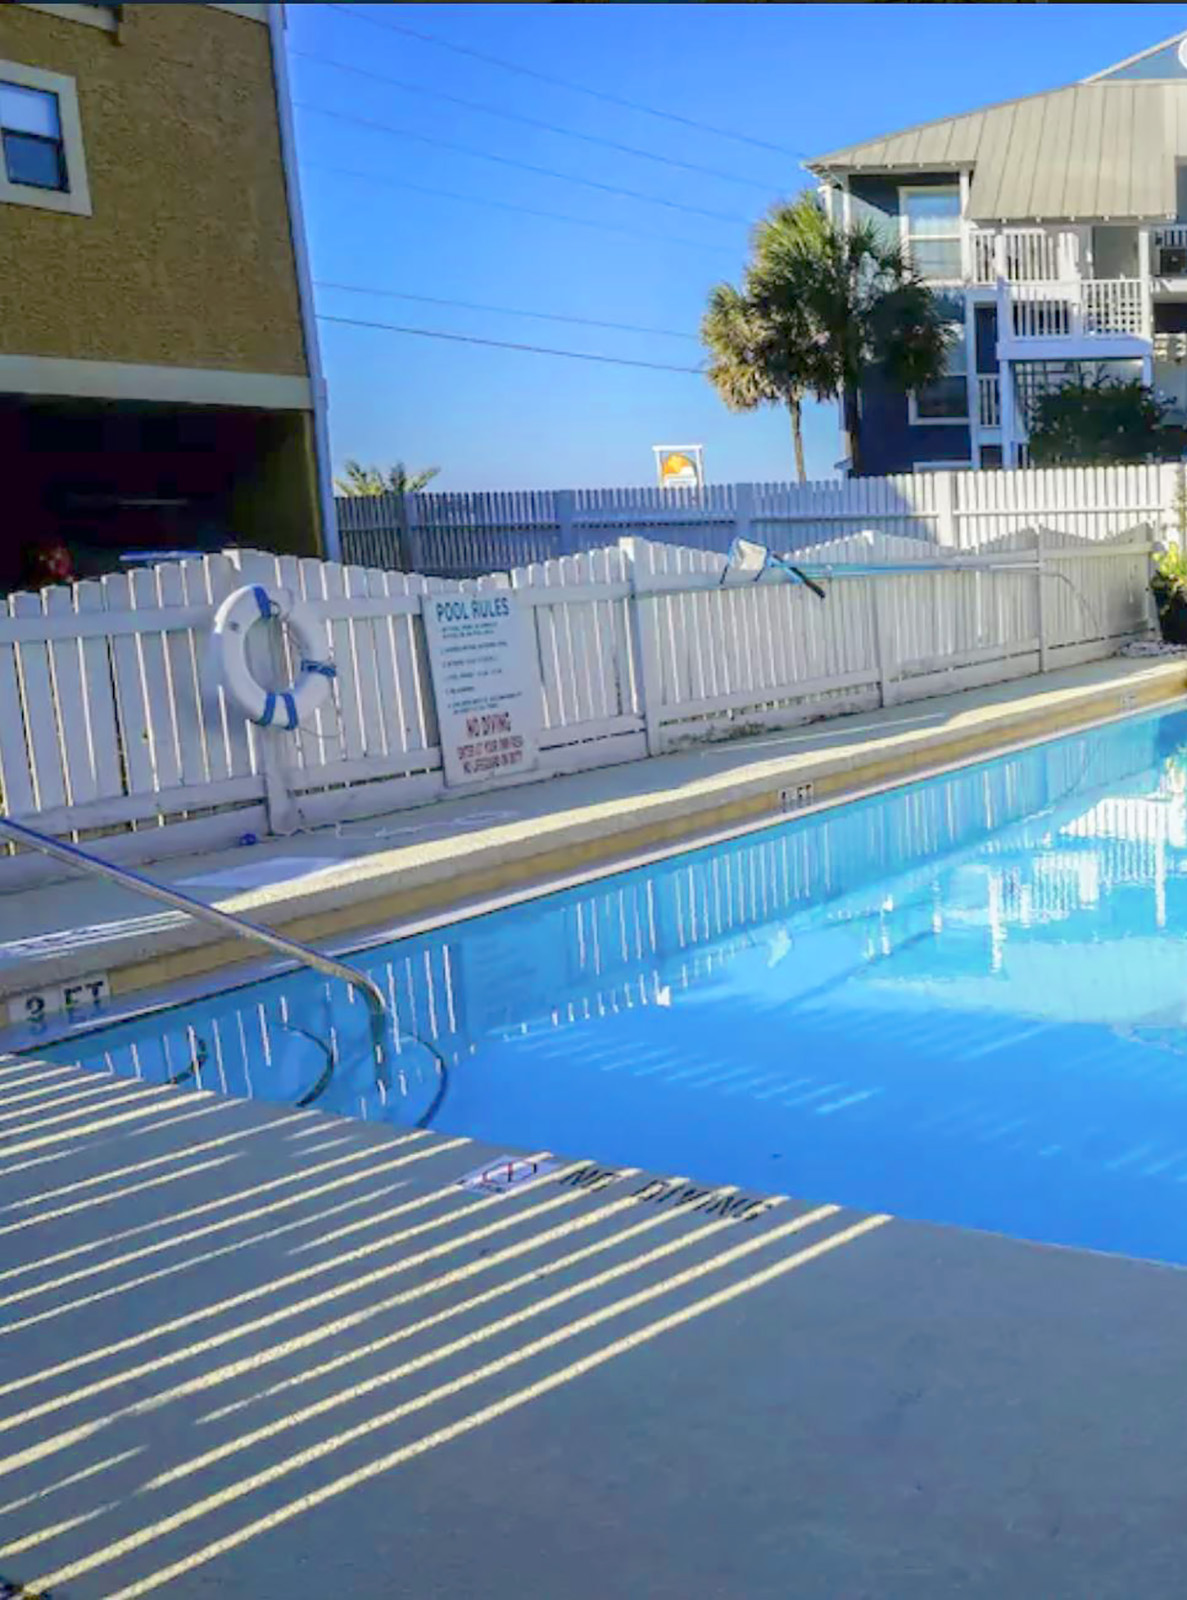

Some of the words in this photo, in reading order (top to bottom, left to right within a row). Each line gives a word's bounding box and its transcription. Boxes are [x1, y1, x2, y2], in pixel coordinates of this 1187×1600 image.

[436, 601, 470, 623] POOL
[472, 597, 510, 619] RULES
[465, 716, 480, 737] NO
[481, 711, 512, 736] DIVING
[630, 1179, 773, 1222] DIVING
